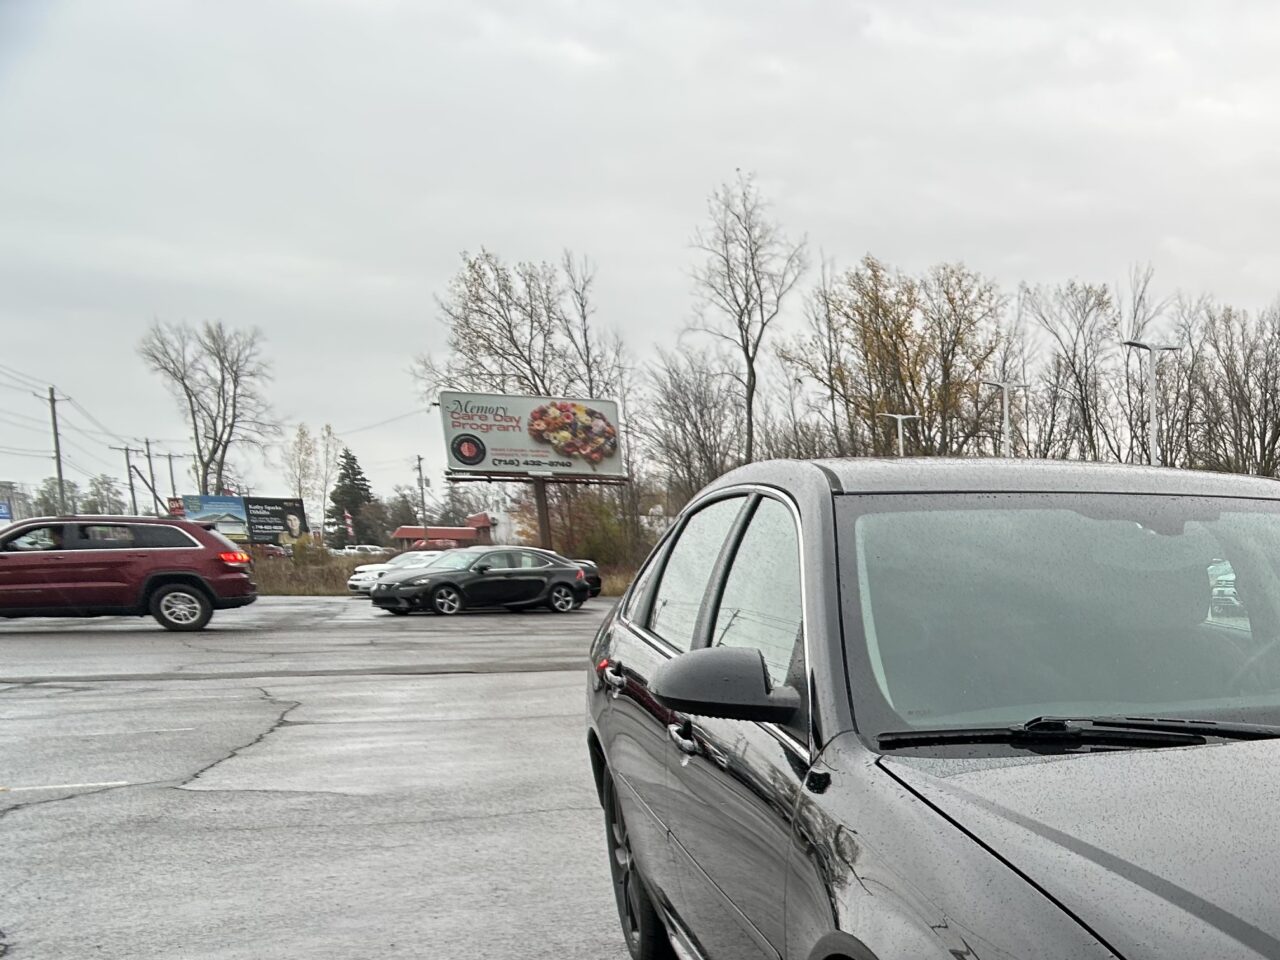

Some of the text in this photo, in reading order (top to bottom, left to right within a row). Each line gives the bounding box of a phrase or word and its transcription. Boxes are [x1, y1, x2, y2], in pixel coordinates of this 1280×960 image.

[446, 400, 508, 415] Memory
[451, 411, 521, 425] Care Day
[452, 421, 521, 433] Program
